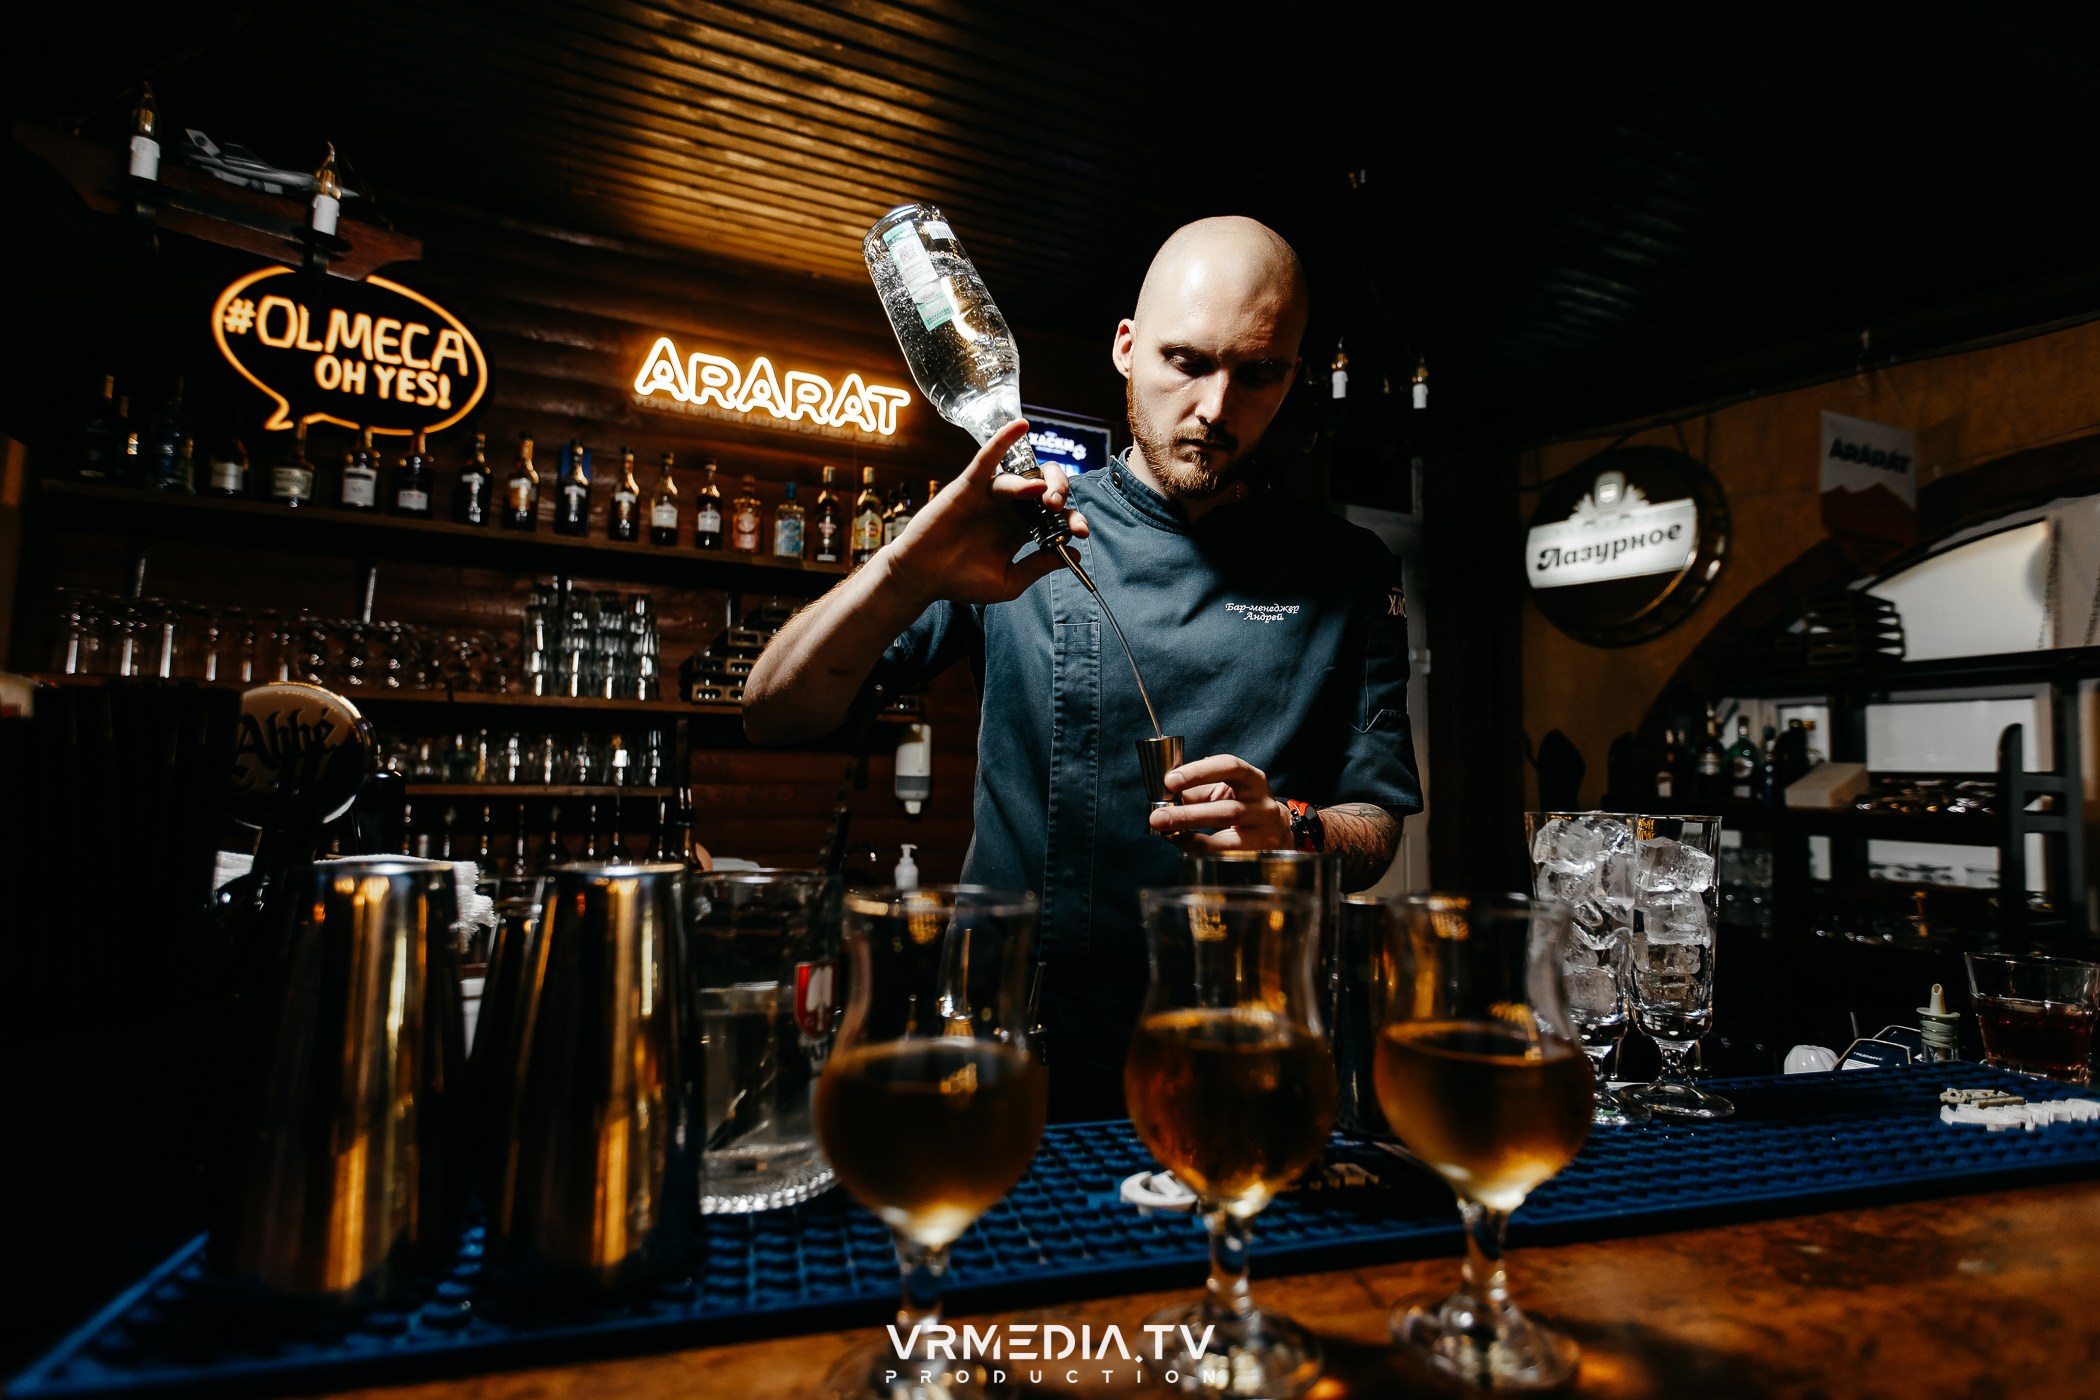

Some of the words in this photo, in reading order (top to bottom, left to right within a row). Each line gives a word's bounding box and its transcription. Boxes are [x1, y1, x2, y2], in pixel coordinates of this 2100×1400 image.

[224, 294, 468, 376] #OLMECA
[314, 353, 367, 395] OH
[373, 362, 452, 410] YES!
[634, 337, 911, 435] ARARAT
[1829, 437, 1912, 474] ARARAT
[1537, 522, 1682, 571] Лазурное
[1225, 602, 1300, 614] Бар-менеджер
[1243, 611, 1285, 624] Андрей
